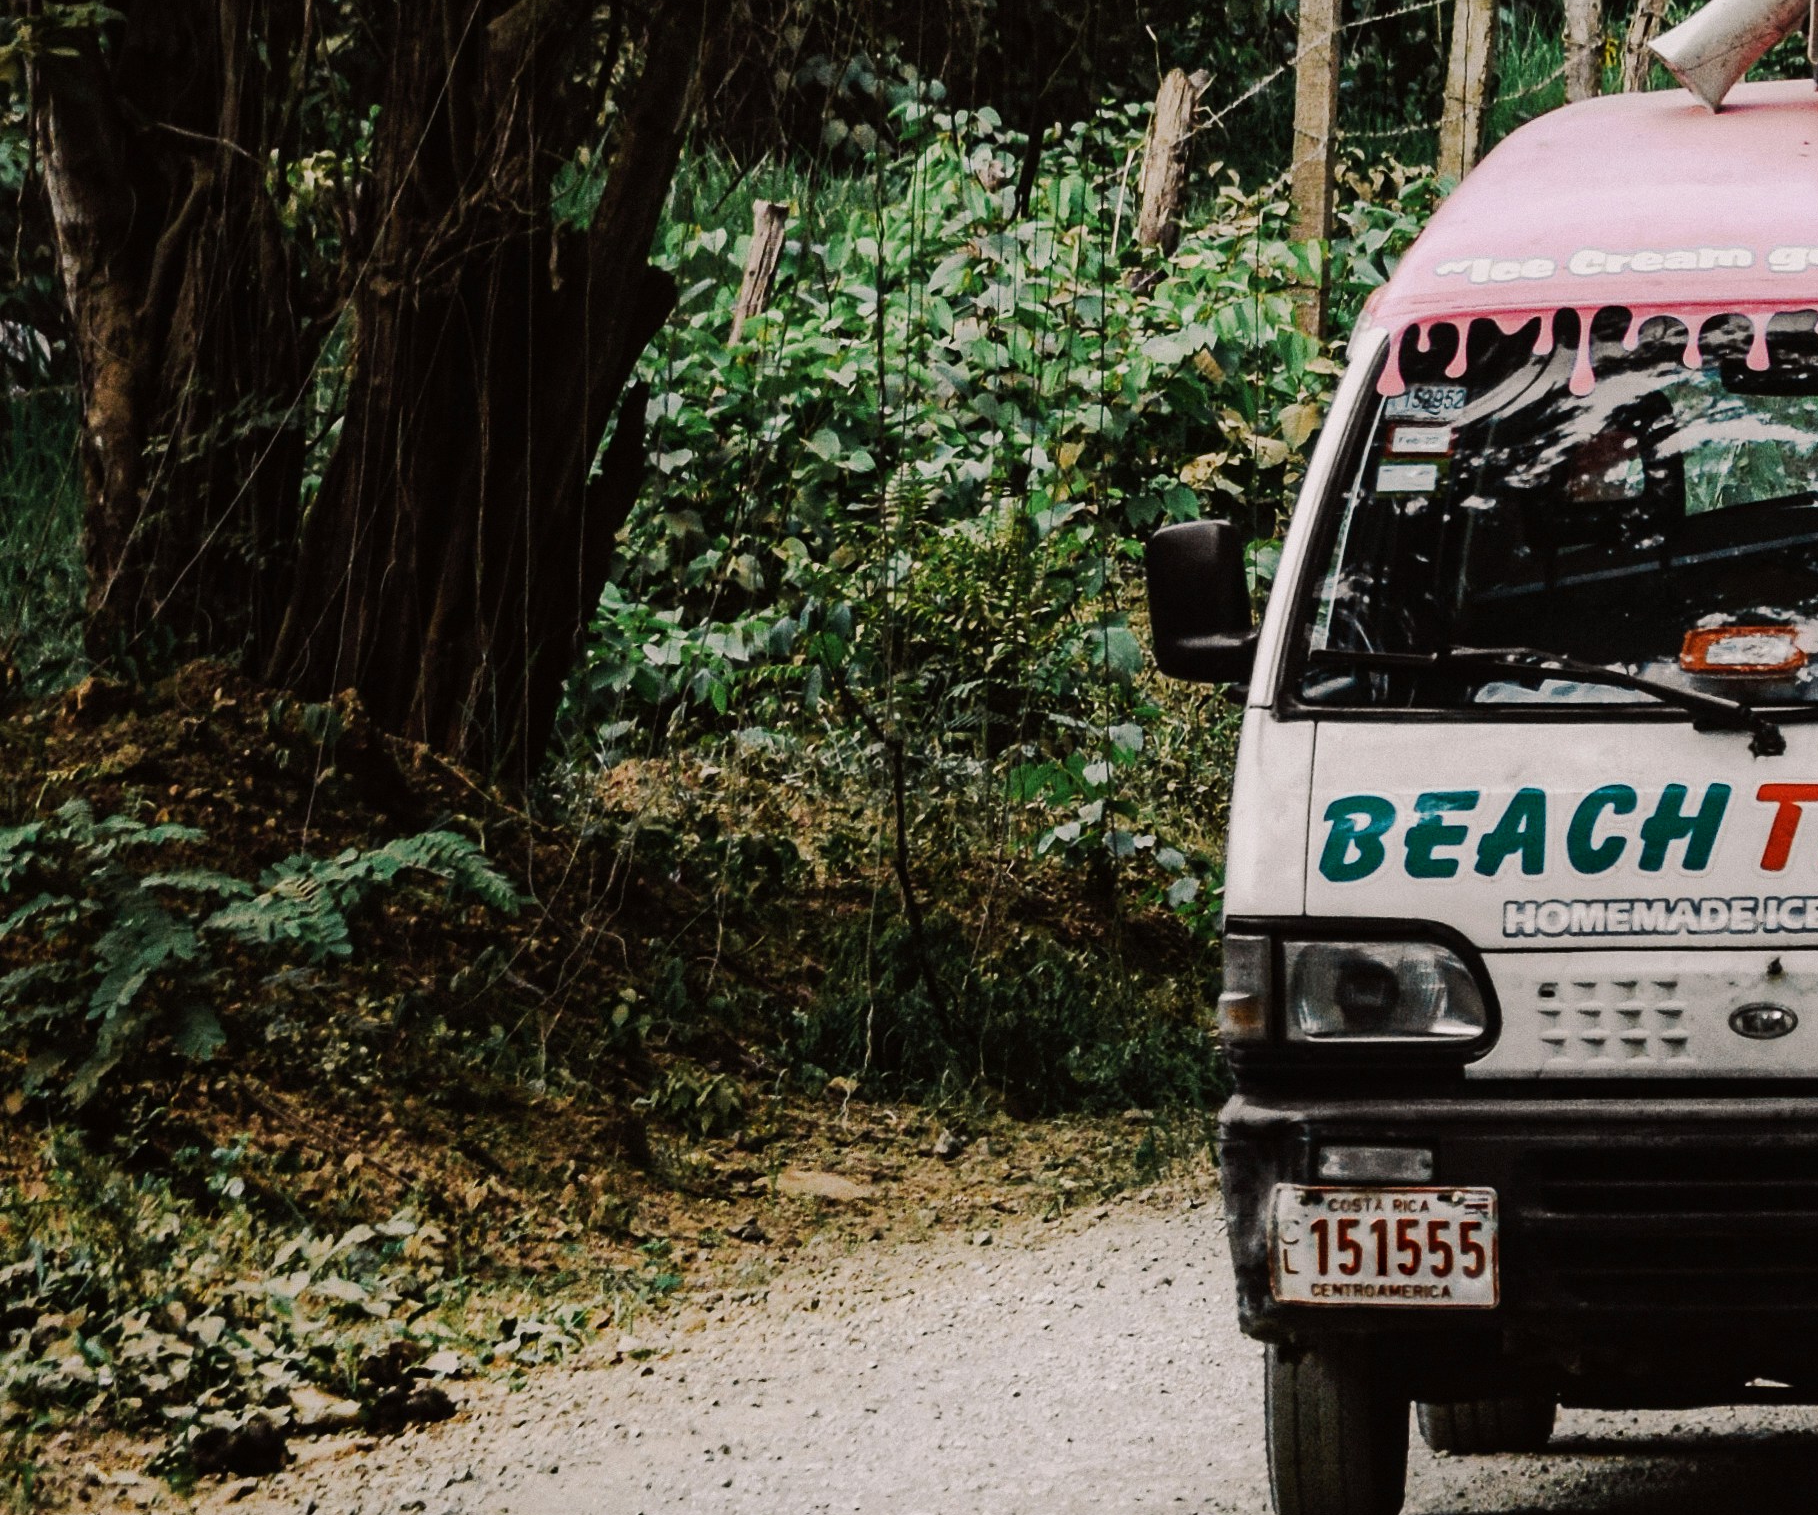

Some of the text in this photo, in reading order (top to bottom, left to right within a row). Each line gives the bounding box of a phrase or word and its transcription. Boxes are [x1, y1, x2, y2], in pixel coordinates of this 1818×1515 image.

[1567, 245, 1756, 276] Cream
[1317, 782, 1732, 884] BEACH
[1503, 898, 1758, 938] HOMEMADE
[1328, 1198, 1430, 1213] COSTA RICA
[1310, 1217, 1487, 1279] 151555
[1311, 1283, 1453, 1299] CENTROAMERICA
